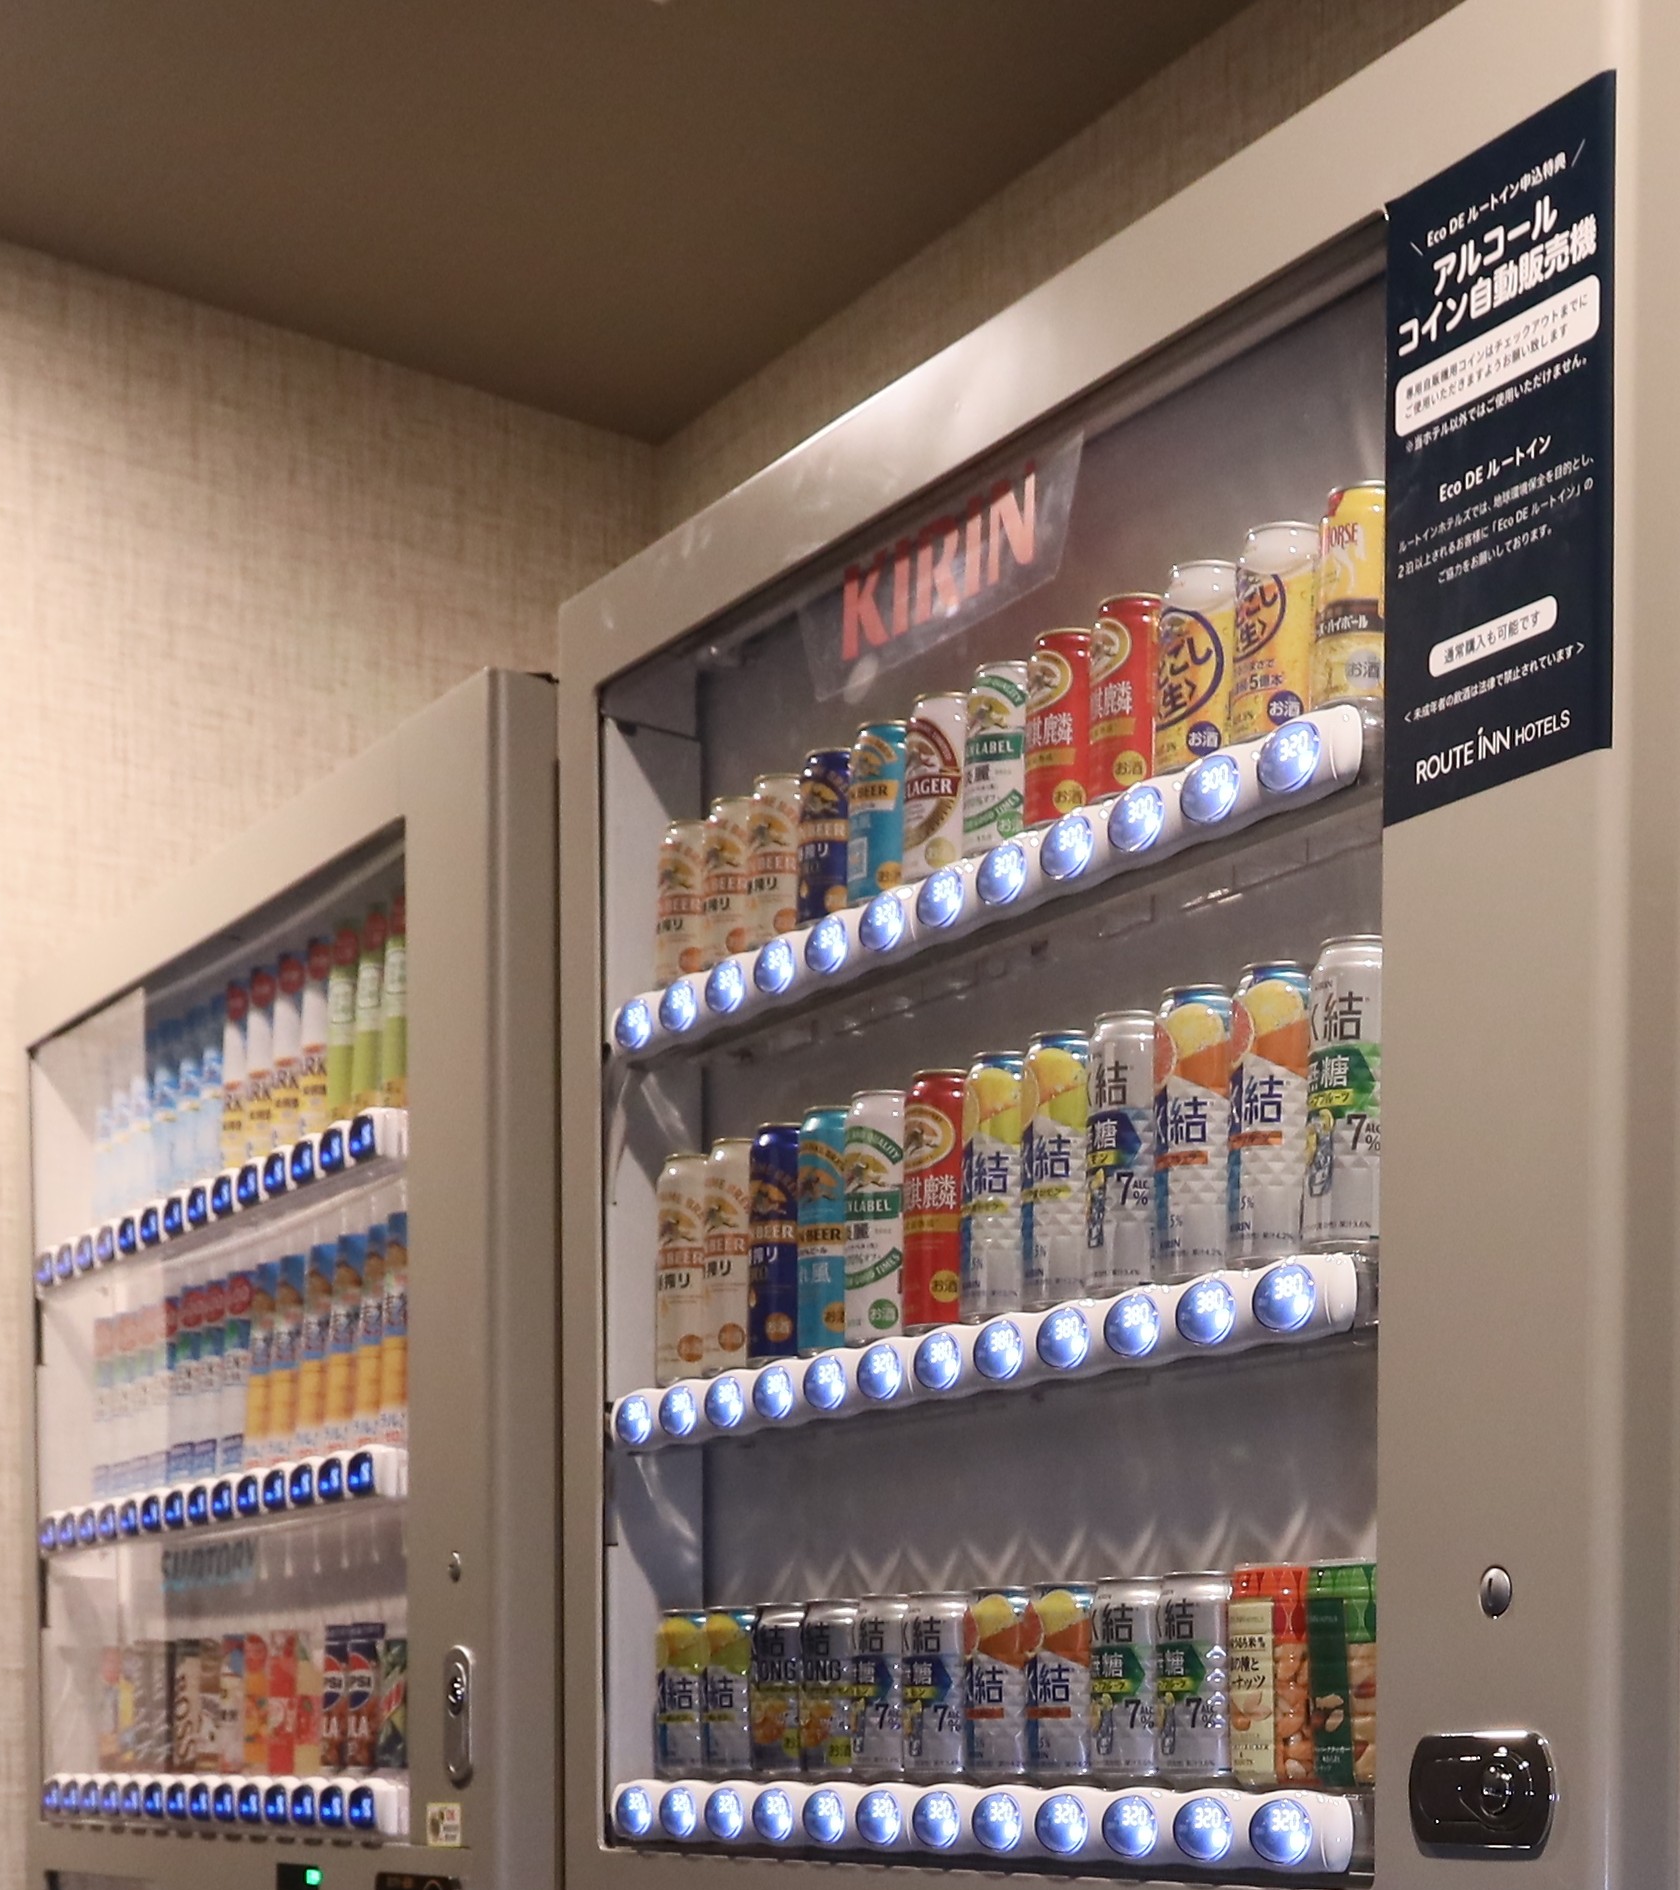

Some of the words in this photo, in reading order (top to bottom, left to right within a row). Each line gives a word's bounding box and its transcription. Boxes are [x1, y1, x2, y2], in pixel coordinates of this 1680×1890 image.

[1427, 229, 1446, 247] Eco
[1449, 212, 1466, 235] DE
[1433, 195, 1558, 296] アルコール
[1398, 213, 1598, 356] コイン自動販売機
[1439, 481, 1462, 502] Eco
[1465, 467, 1484, 489] DE
[1486, 435, 1552, 480] ルートイン
[842, 461, 1037, 662] KIRIN
[1348, 661, 1381, 678] お酒
[1270, 700, 1301, 718] お酒
[975, 739, 1014, 754] LABEL
[1187, 730, 1219, 748] お酒
[1416, 742, 1474, 784] ROUTE
[1514, 708, 1571, 746] HOTELS
[907, 777, 953, 796] LAGER
[1201, 763, 1229, 794] 300
[1128, 797, 1154, 823] 300
[1059, 824, 1083, 851] 300
[1347, 1113, 1367, 1150] 7
[1115, 1172, 1135, 1206] 7
[1132, 1191, 1149, 1206] %
[853, 1199, 892, 1213] LABEL
[806, 1227, 841, 1241] BEER
[1272, 1273, 1303, 1299] 380
[1195, 1288, 1224, 1314] 380
[1123, 1302, 1149, 1327] 380
[1055, 1316, 1080, 1341] 380
[931, 1340, 954, 1364] 380
[990, 1329, 1014, 1352] 380
[872, 1351, 895, 1374] 320
[805, 1660, 841, 1681] ONG
[875, 1703, 889, 1731] 7
[934, 1704, 948, 1732] 7
[1124, 1698, 1142, 1729] 7
[1185, 1697, 1202, 1729] 7
[718, 1794, 738, 1812] 320
[766, 1795, 787, 1814] 320
[818, 1795, 839, 1816] 320
[872, 1796, 896, 1818] 320
[929, 1799, 954, 1819] 320
[989, 1800, 1015, 1822] 320
[1053, 1803, 1079, 1824] 320
[1122, 1804, 1148, 1826] 320
[1194, 1807, 1222, 1829] 320
[1270, 1808, 1301, 1831] 320
